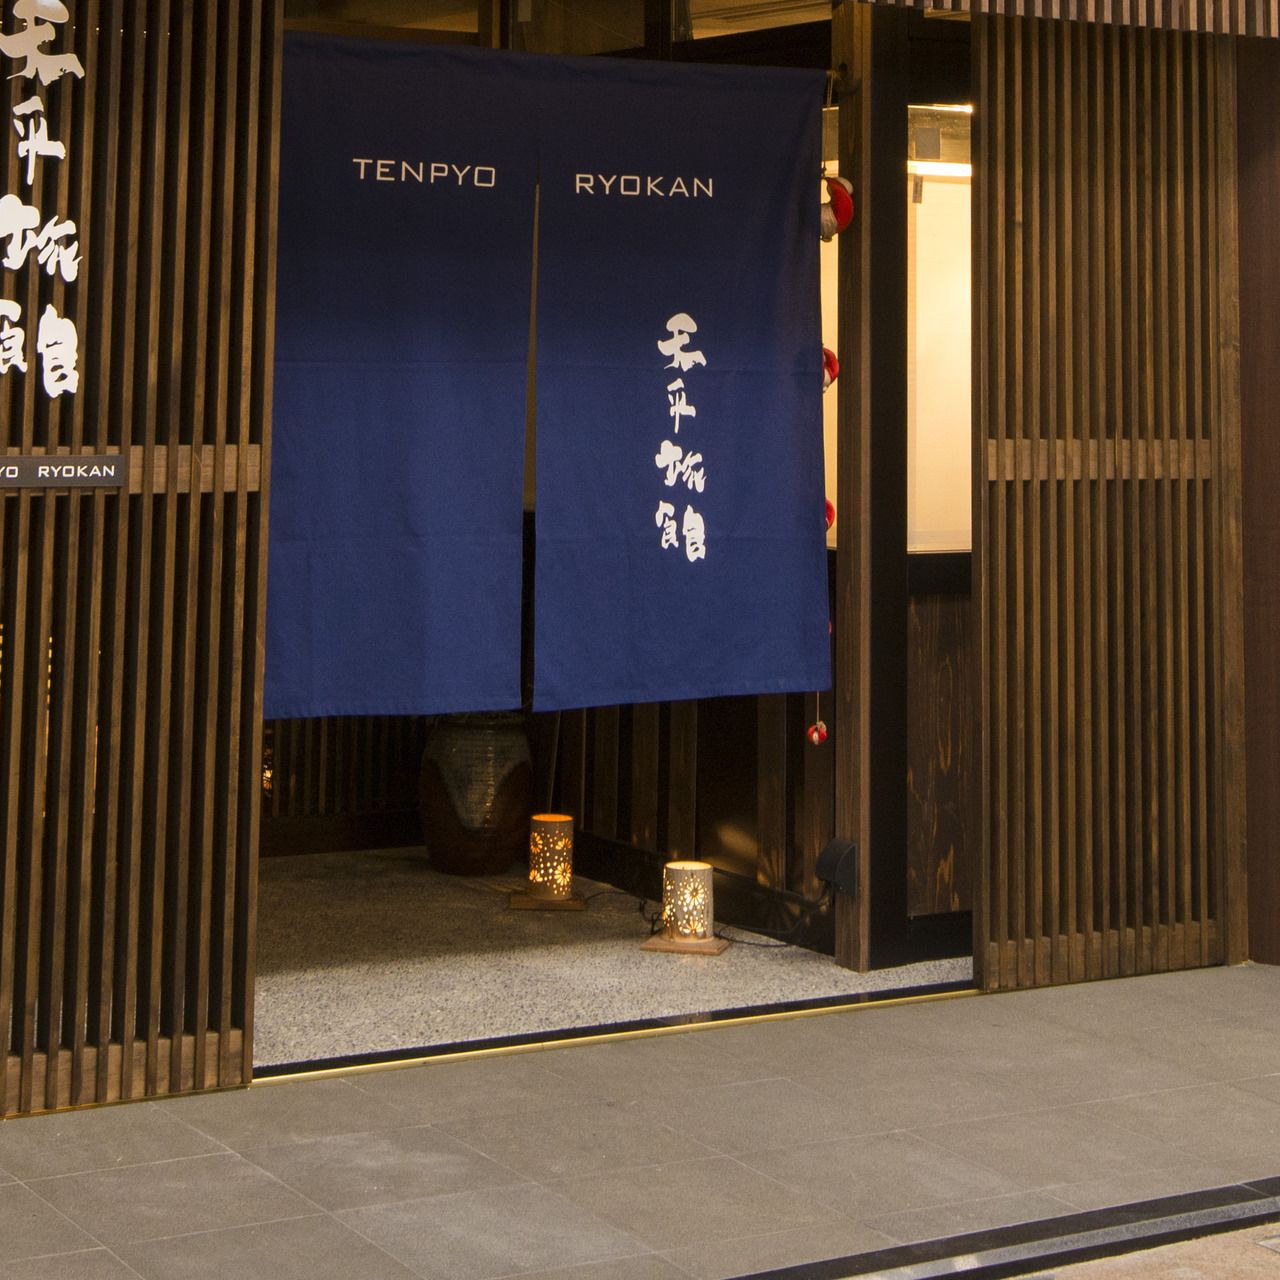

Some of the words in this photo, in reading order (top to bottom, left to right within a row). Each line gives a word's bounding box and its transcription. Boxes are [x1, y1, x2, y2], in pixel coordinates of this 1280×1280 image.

[352, 158, 496, 190] TENPYO
[575, 172, 714, 199] RYOKAN
[654, 312, 707, 563] 天平旅館
[36, 464, 116, 479] RYOKAN
